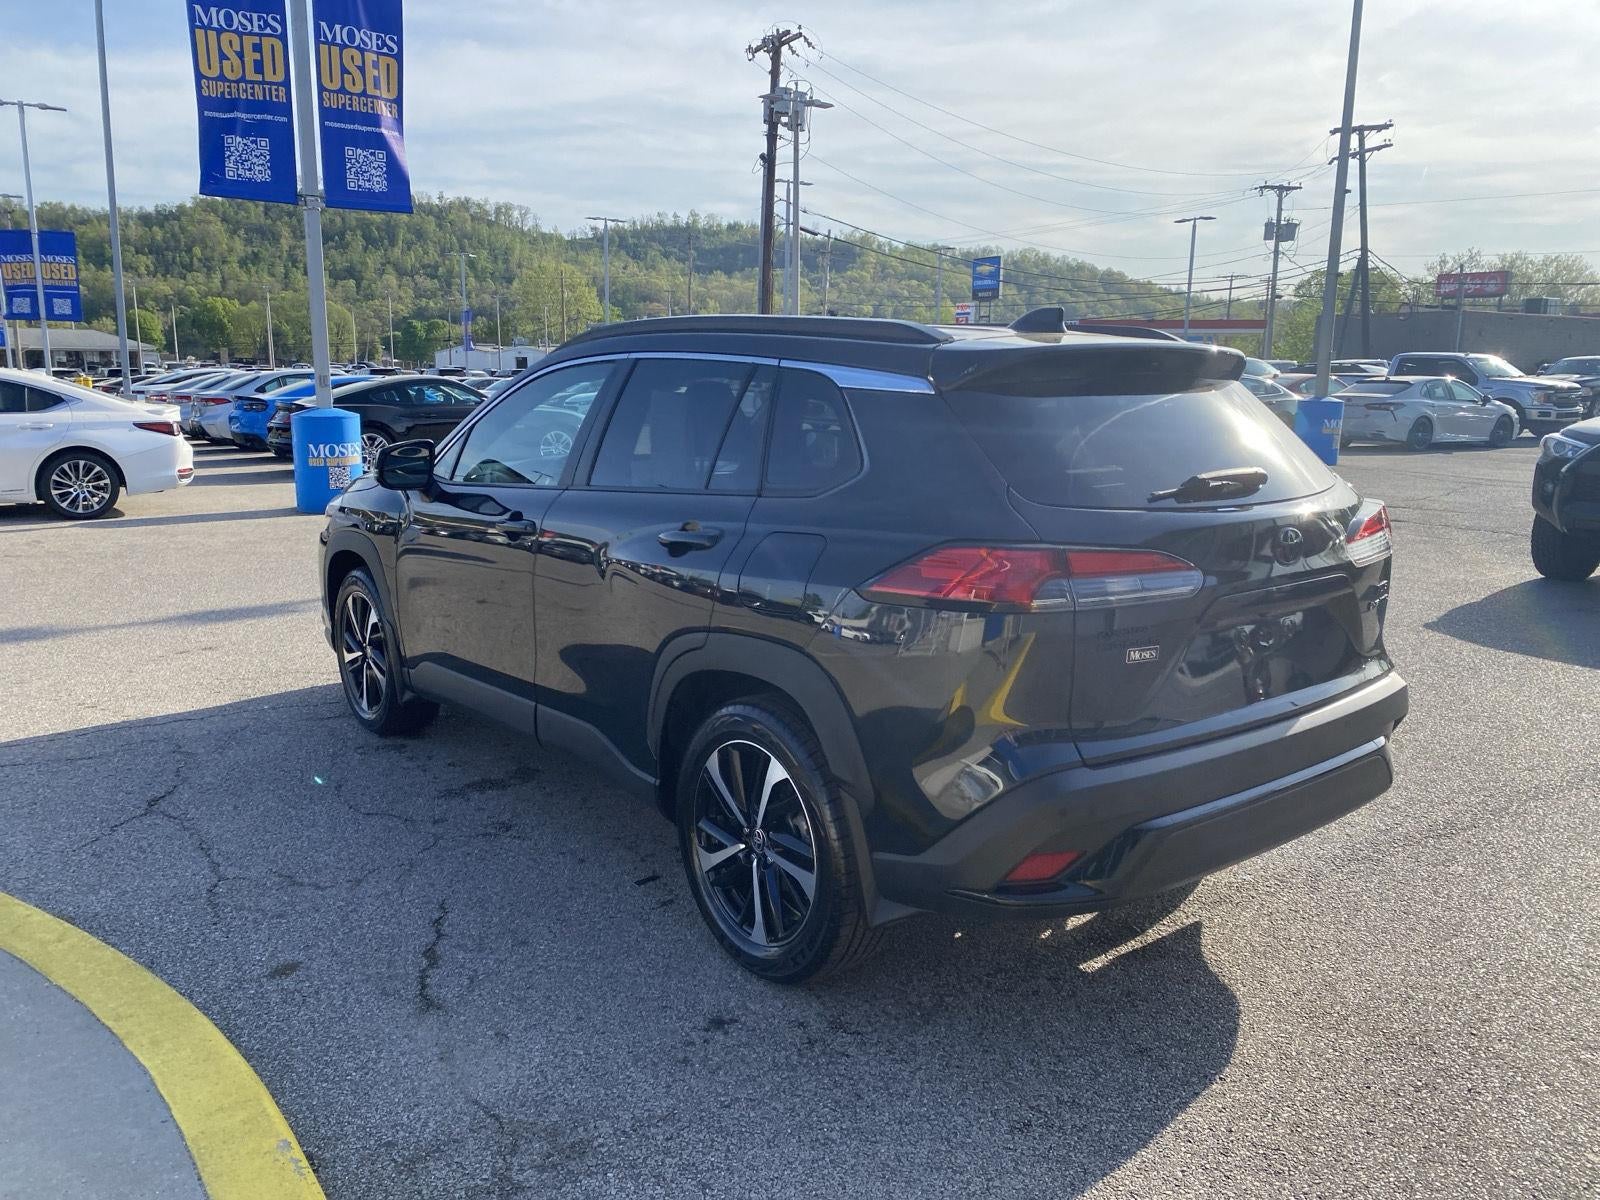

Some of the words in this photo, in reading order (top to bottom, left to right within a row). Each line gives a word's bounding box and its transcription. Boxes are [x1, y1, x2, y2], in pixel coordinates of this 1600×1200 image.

[193, 4, 282, 35] MOSES
[319, 21, 398, 54] MOSES
[195, 28, 285, 83] USED
[319, 44, 398, 100] USED
[201, 78, 287, 103] SUPERCENTER
[322, 91, 398, 119] SUPERCENTER
[0, 254, 34, 263] MOSES
[41, 255, 75, 263] MOSES
[2, 262, 35, 280] USED
[41, 262, 77, 280] USED
[308, 442, 361, 458] MOSES
[1130, 650, 1156, 660] MOSES
